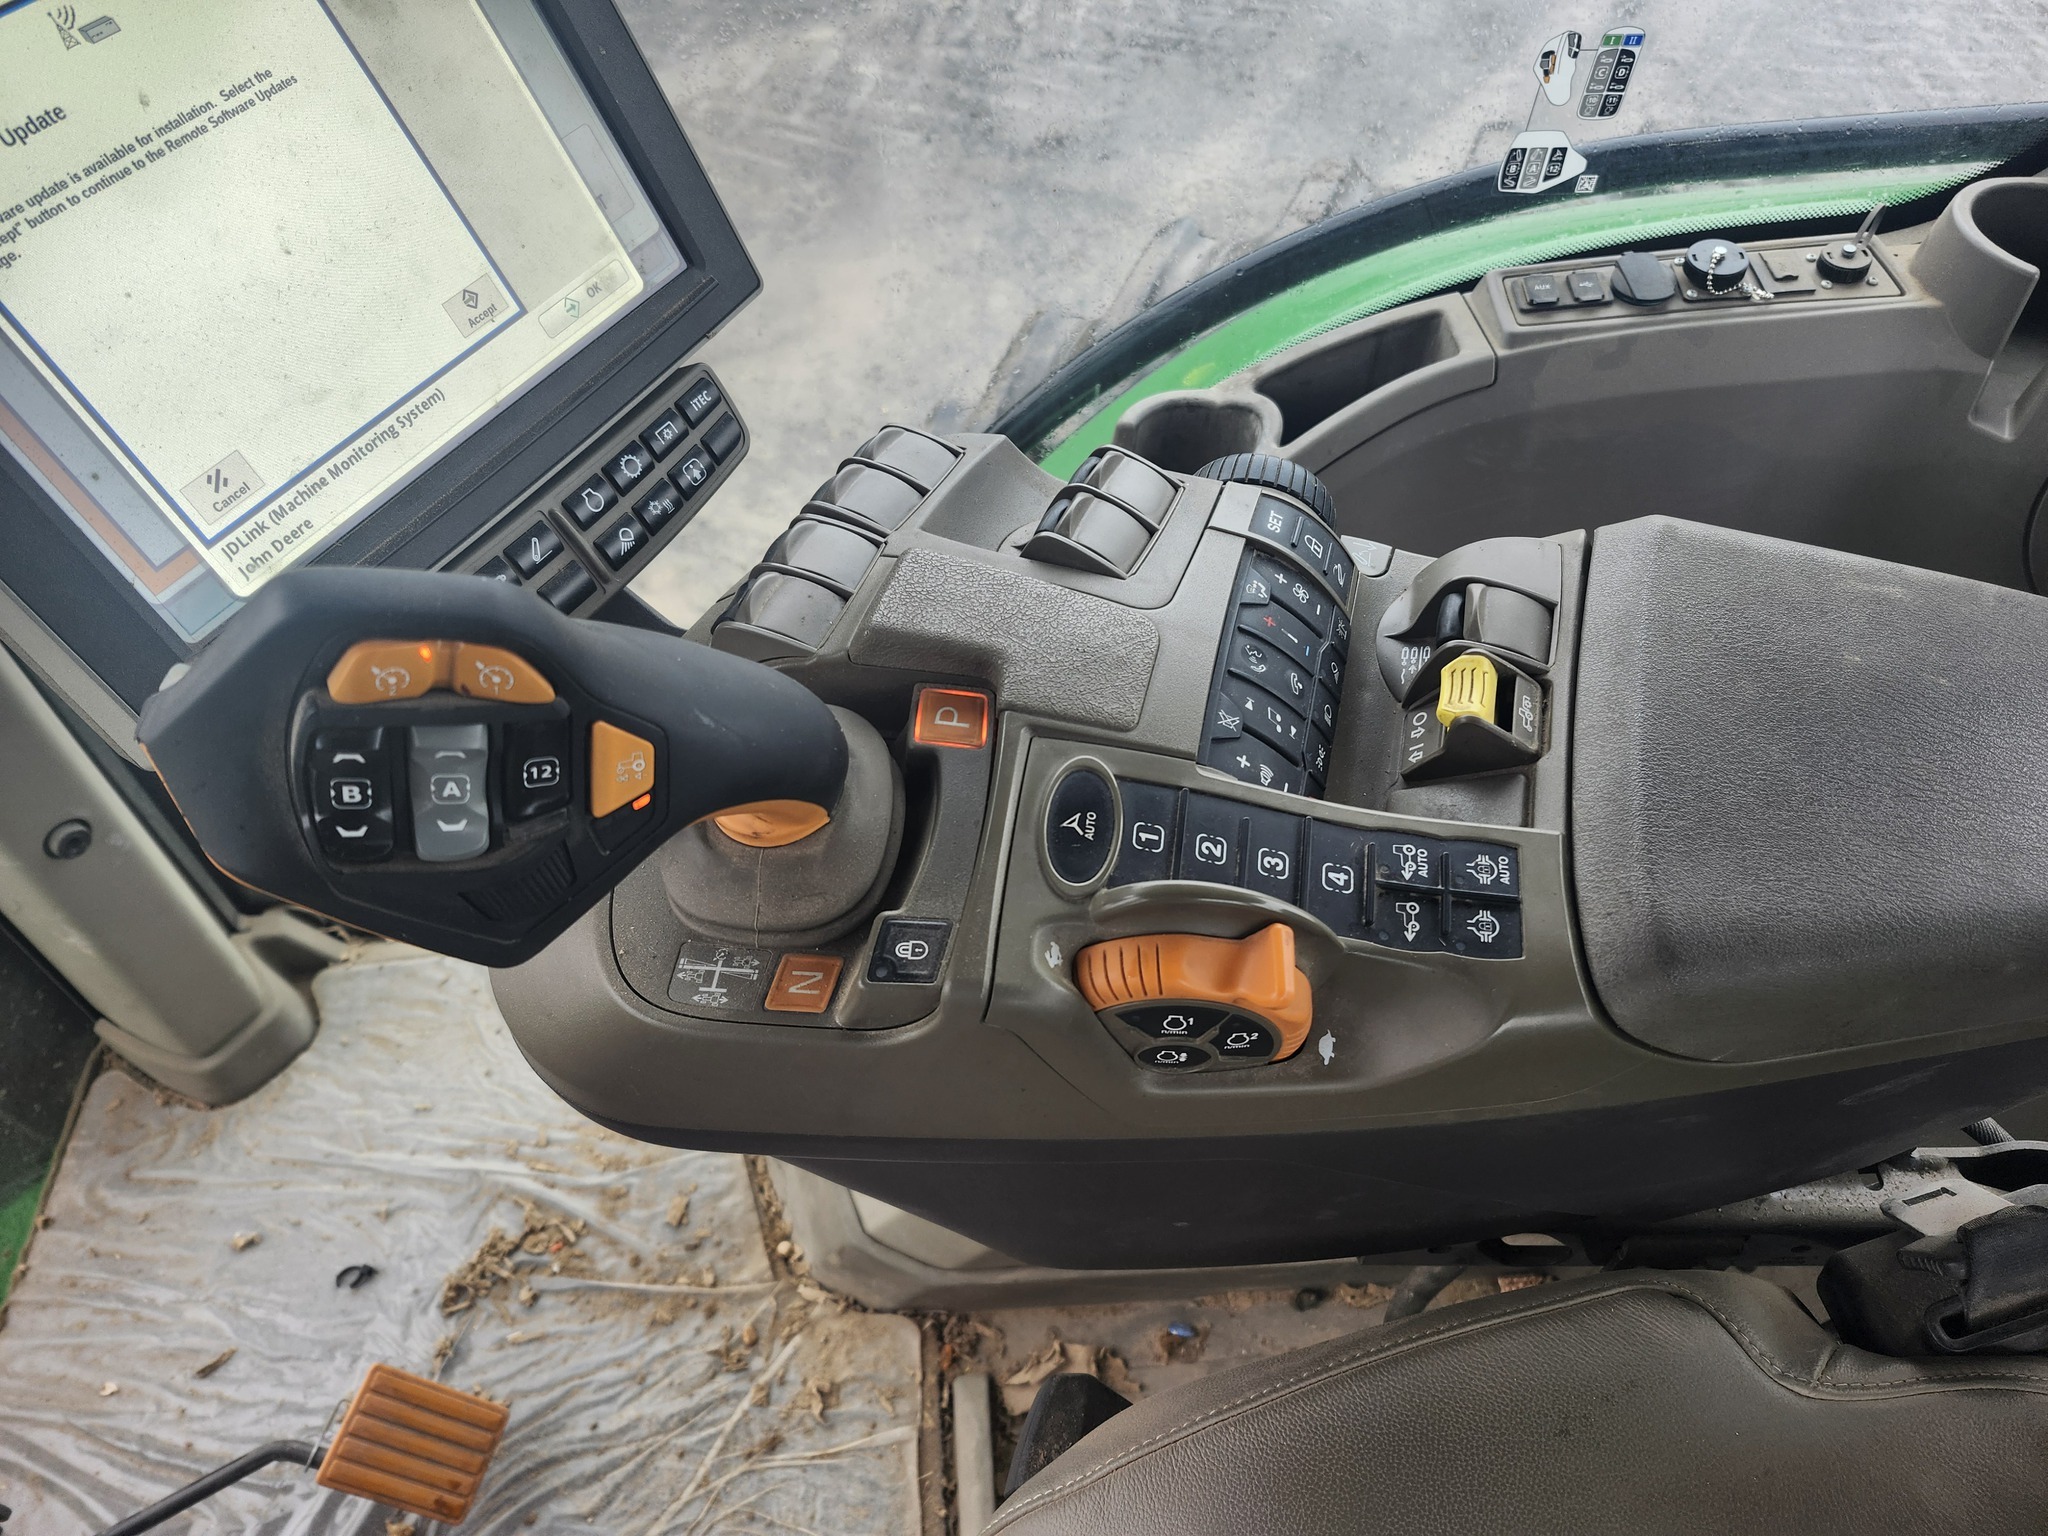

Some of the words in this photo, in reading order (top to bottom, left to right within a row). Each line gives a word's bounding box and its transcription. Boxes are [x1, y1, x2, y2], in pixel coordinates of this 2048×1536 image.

[0, 106, 67, 147] Update
[25, 179, 70, 207] update
[66, 172, 82, 184] is
[82, 144, 137, 178] available
[135, 132, 154, 148] for
[152, 100, 218, 138] installation.
[219, 77, 256, 102] Select
[253, 68, 273, 85] the
[0, 221, 22, 246] ept"
[24, 202, 68, 230] button
[65, 194, 81, 207] to
[81, 166, 133, 199] continue
[131, 158, 146, 171] to
[145, 147, 166, 164] the
[163, 124, 209, 152] Remote
[207, 98, 257, 128] Software
[254, 74, 298, 102] Updates
[586, 281, 603, 299] OK
[467, 302, 498, 328] Accept
[689, 390, 712, 412] iTEC
[221, 519, 271, 562] JDLink
[268, 474, 330, 526] (Machine
[326, 425, 400, 481] Monitoring
[396, 387, 446, 430] System)
[212, 481, 251, 513] Cancel
[1267, 510, 1284, 533] SET
[237, 548, 273, 582] John
[271, 517, 314, 554] Deere
[934, 706, 970, 728] P
[529, 765, 552, 781] 12
[341, 785, 362, 803] B
[442, 781, 462, 798] A
[1084, 811, 1097, 841] AUTO
[1138, 832, 1160, 842] 1
[1201, 841, 1222, 858] 2
[1263, 855, 1285, 872] 3
[1417, 848, 1429, 878] AUTO
[1498, 855, 1511, 885] AUTO
[1327, 870, 1349, 886] 4
[788, 970, 824, 995] N
[1187, 1017, 1194, 1026] 1
[1250, 1032, 1259, 1040] 2
